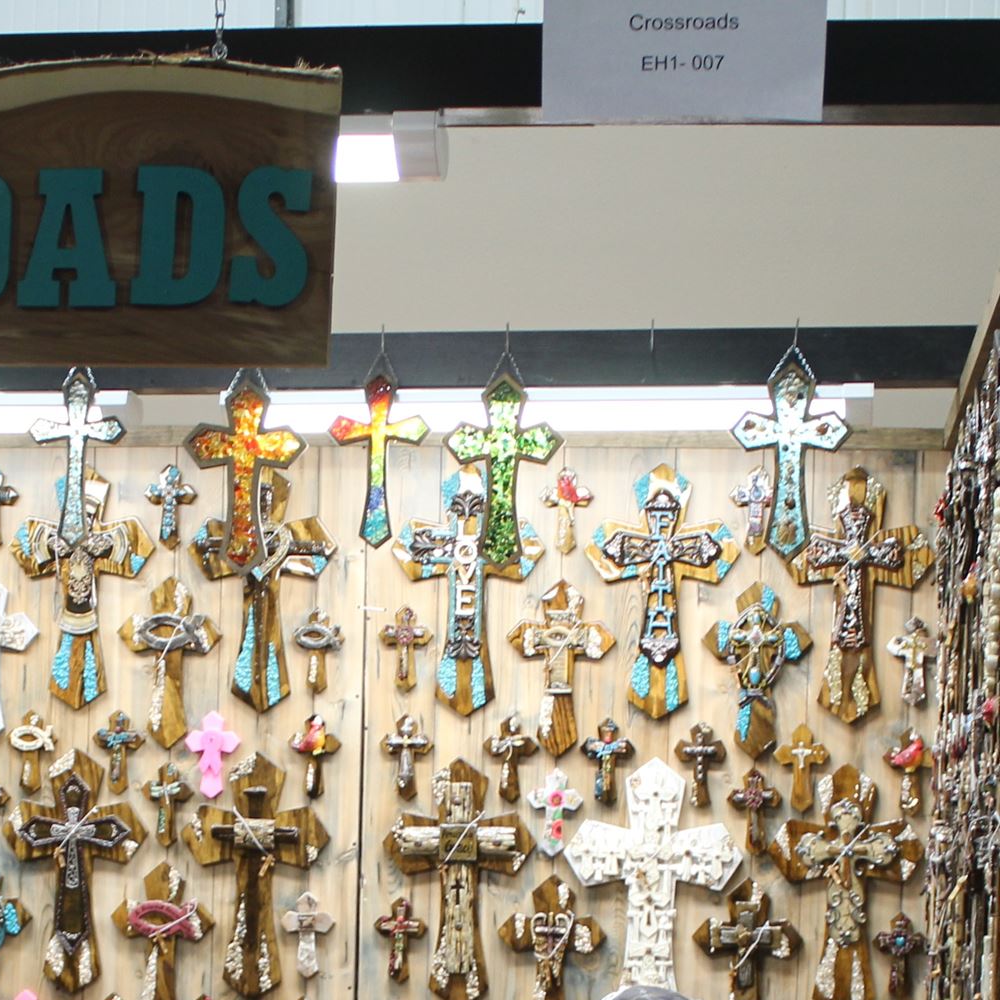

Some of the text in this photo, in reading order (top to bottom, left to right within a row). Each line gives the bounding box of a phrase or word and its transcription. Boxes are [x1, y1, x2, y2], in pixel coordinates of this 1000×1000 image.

[629, 13, 740, 31] Crossroads
[641, 54, 725, 71] EH1- 007
[454, 520, 479, 615] LOVE
[647, 511, 676, 640] FAITH
